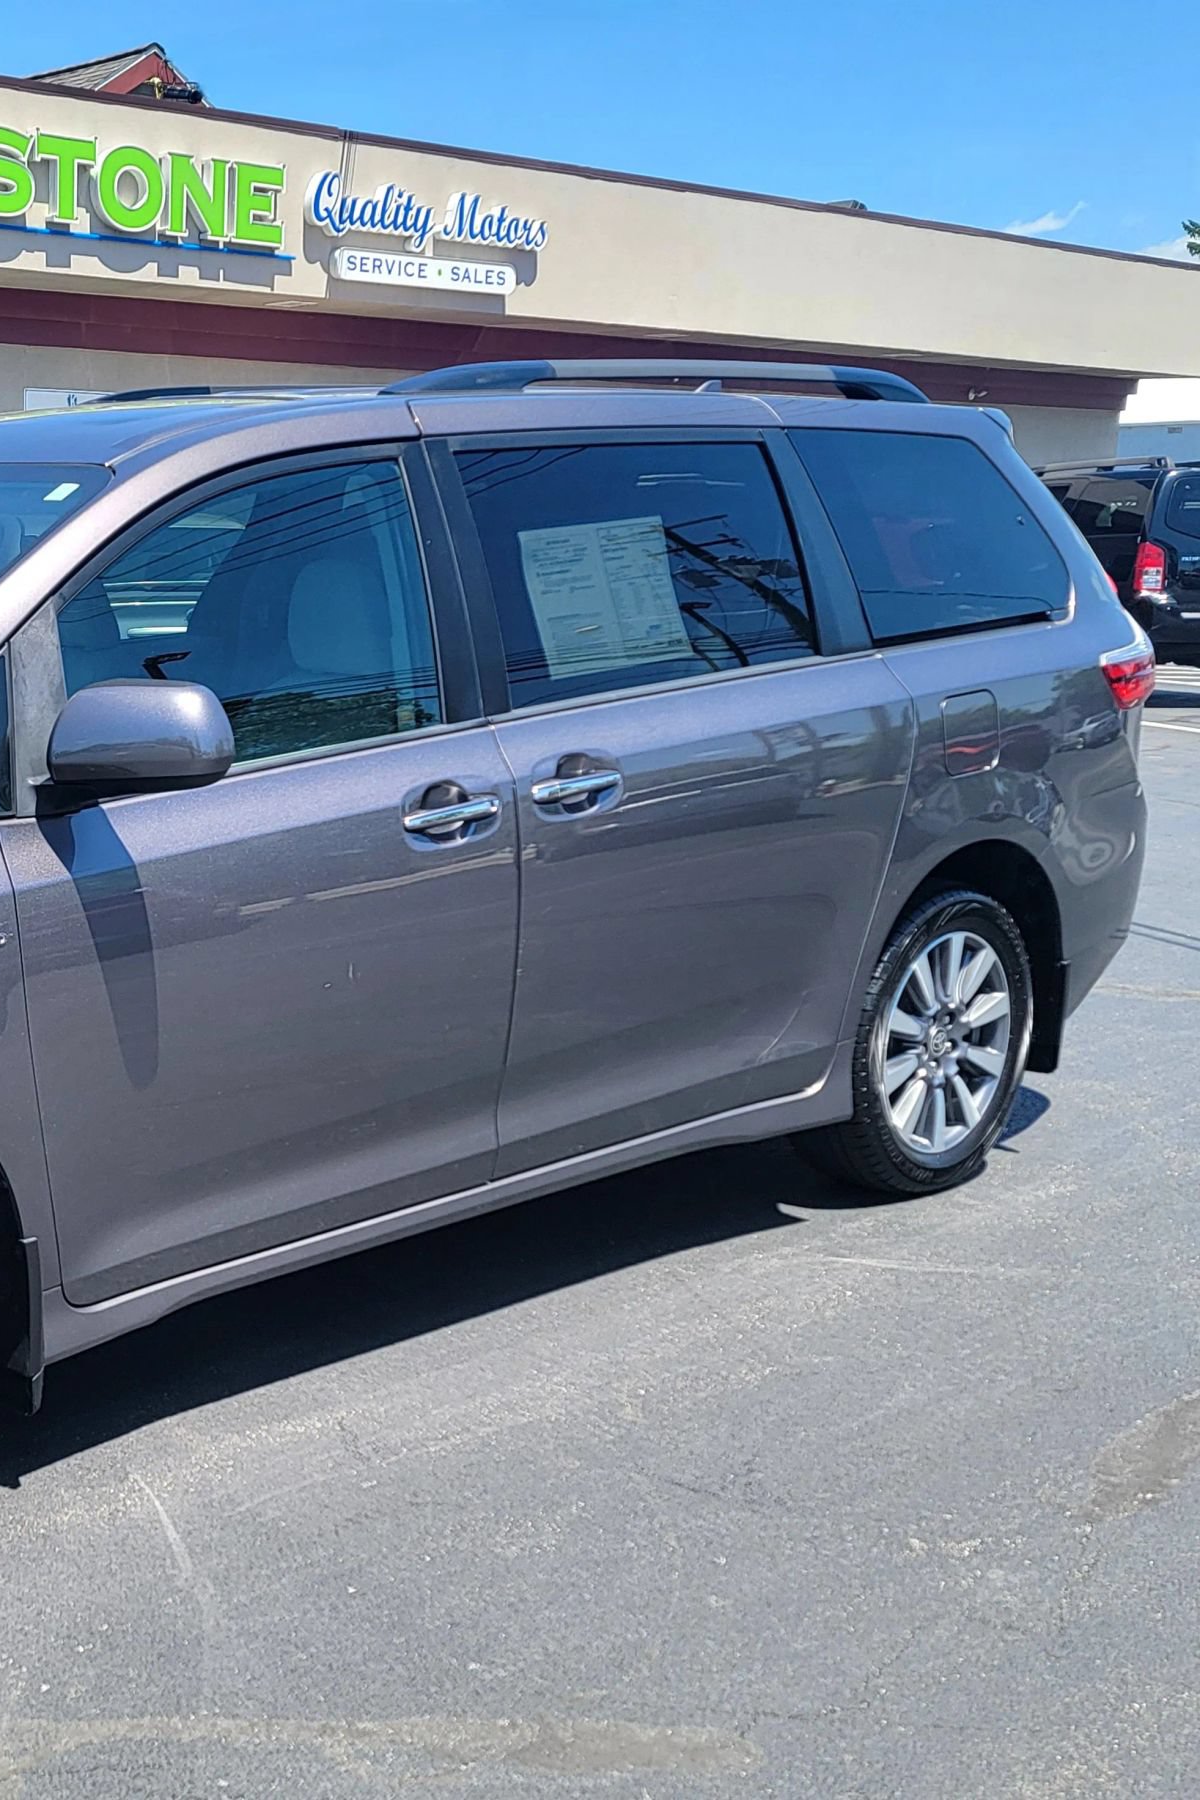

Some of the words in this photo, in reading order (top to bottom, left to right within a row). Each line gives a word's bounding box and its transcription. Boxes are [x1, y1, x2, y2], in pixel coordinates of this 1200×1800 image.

[310, 169, 435, 250] Quality
[442, 190, 549, 251] Motors
[346, 254, 429, 279] SERVICE
[450, 266, 507, 287] SALES
